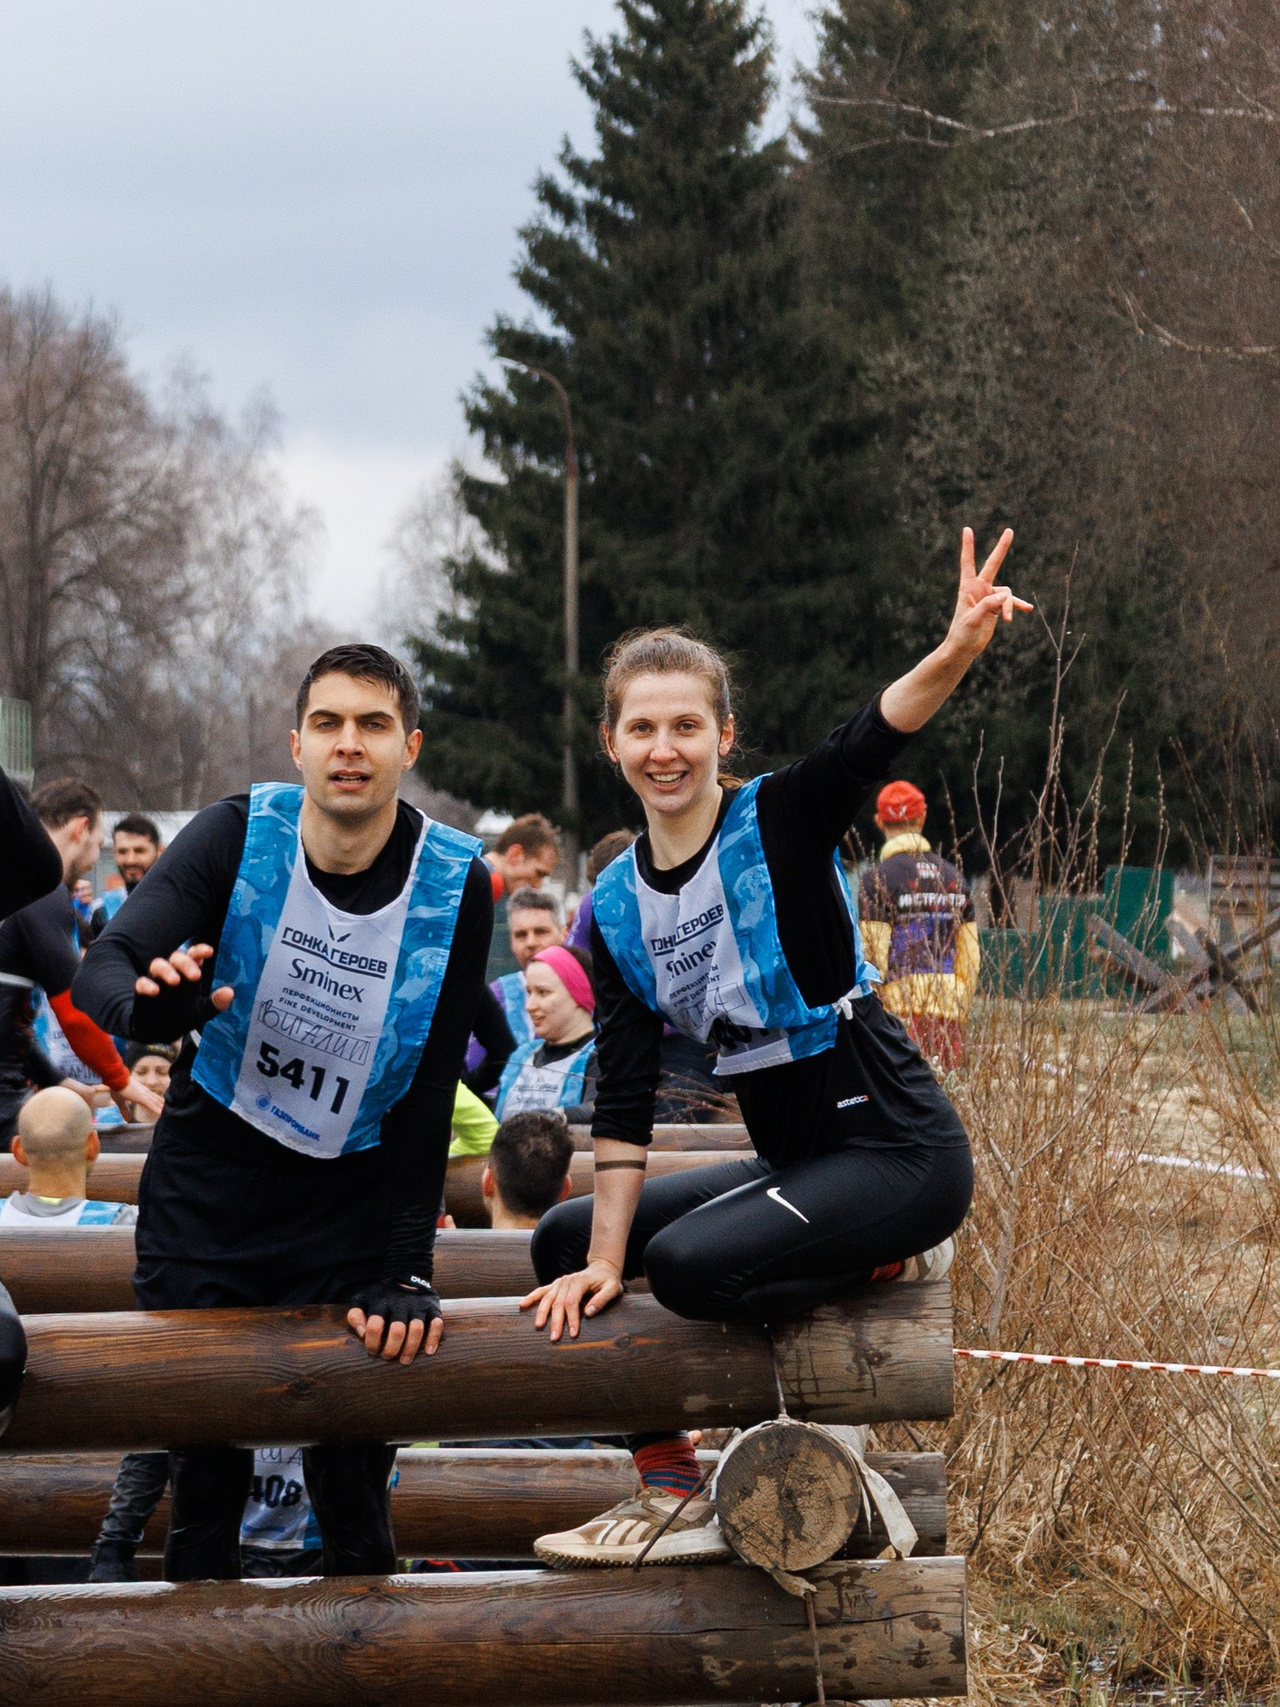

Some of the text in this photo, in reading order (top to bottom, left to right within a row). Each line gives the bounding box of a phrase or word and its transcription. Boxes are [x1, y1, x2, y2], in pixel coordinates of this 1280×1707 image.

[677, 903, 725, 940] ГЕРОЕВ
[282, 926, 387, 974] ГОНКА ГЕРОЕВ
[287, 958, 365, 1003] Sminex
[279, 997, 357, 1032] FINE DEVELOPMENT
[281, 986, 360, 1021] ПЕРФЕКЦИОНИСТЫ
[256, 1040, 350, 1115] 5411
[270, 1105, 321, 1142] ГАЗПРОМБАНК
